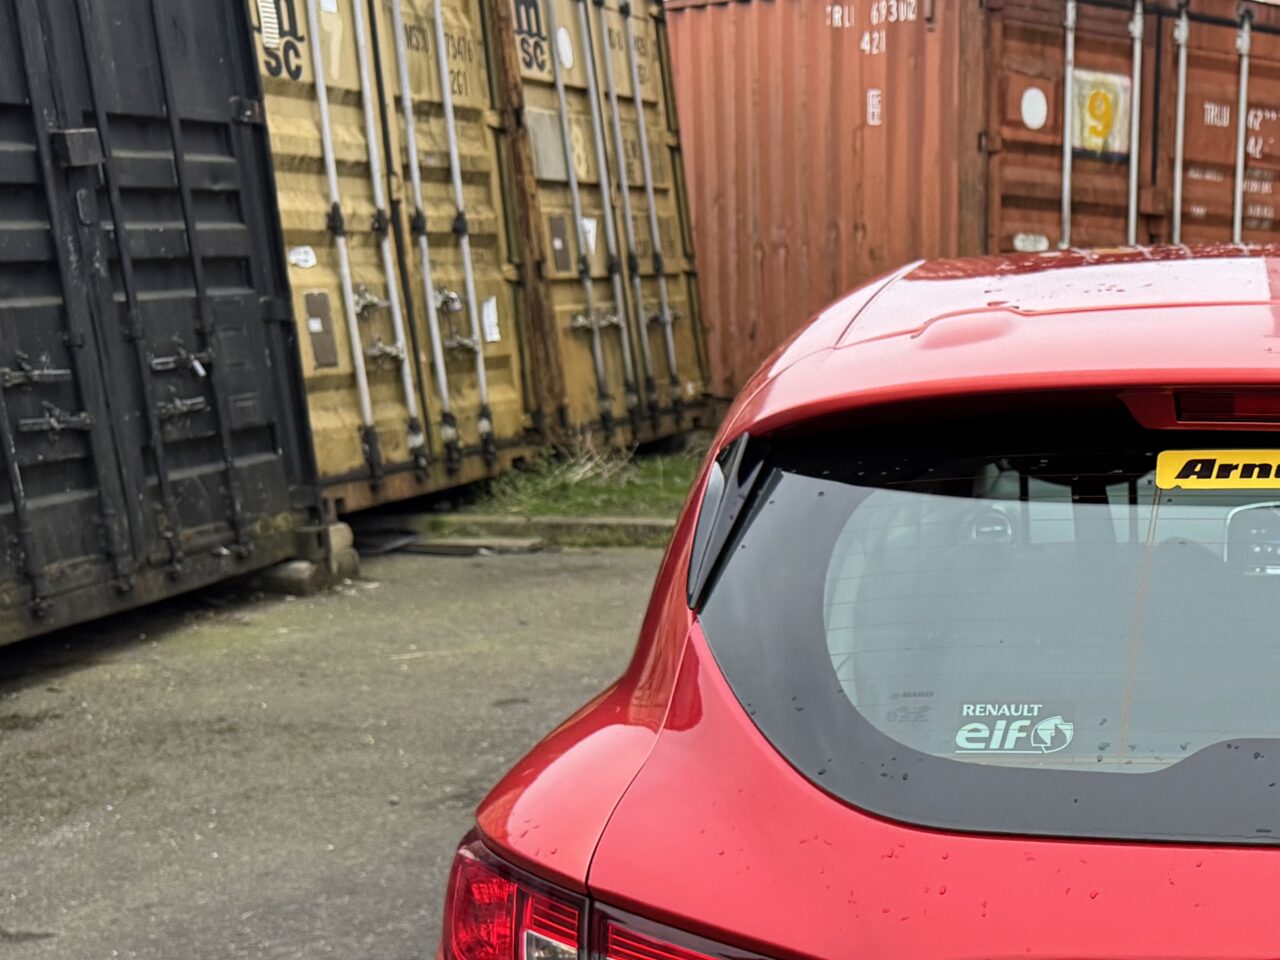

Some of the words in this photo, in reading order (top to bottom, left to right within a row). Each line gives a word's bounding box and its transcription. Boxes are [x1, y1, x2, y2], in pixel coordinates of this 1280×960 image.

[520, 37, 547, 72] SC
[1088, 89, 1115, 139] 9
[962, 704, 1042, 717] RENAULT
[955, 719, 1031, 750] elf
